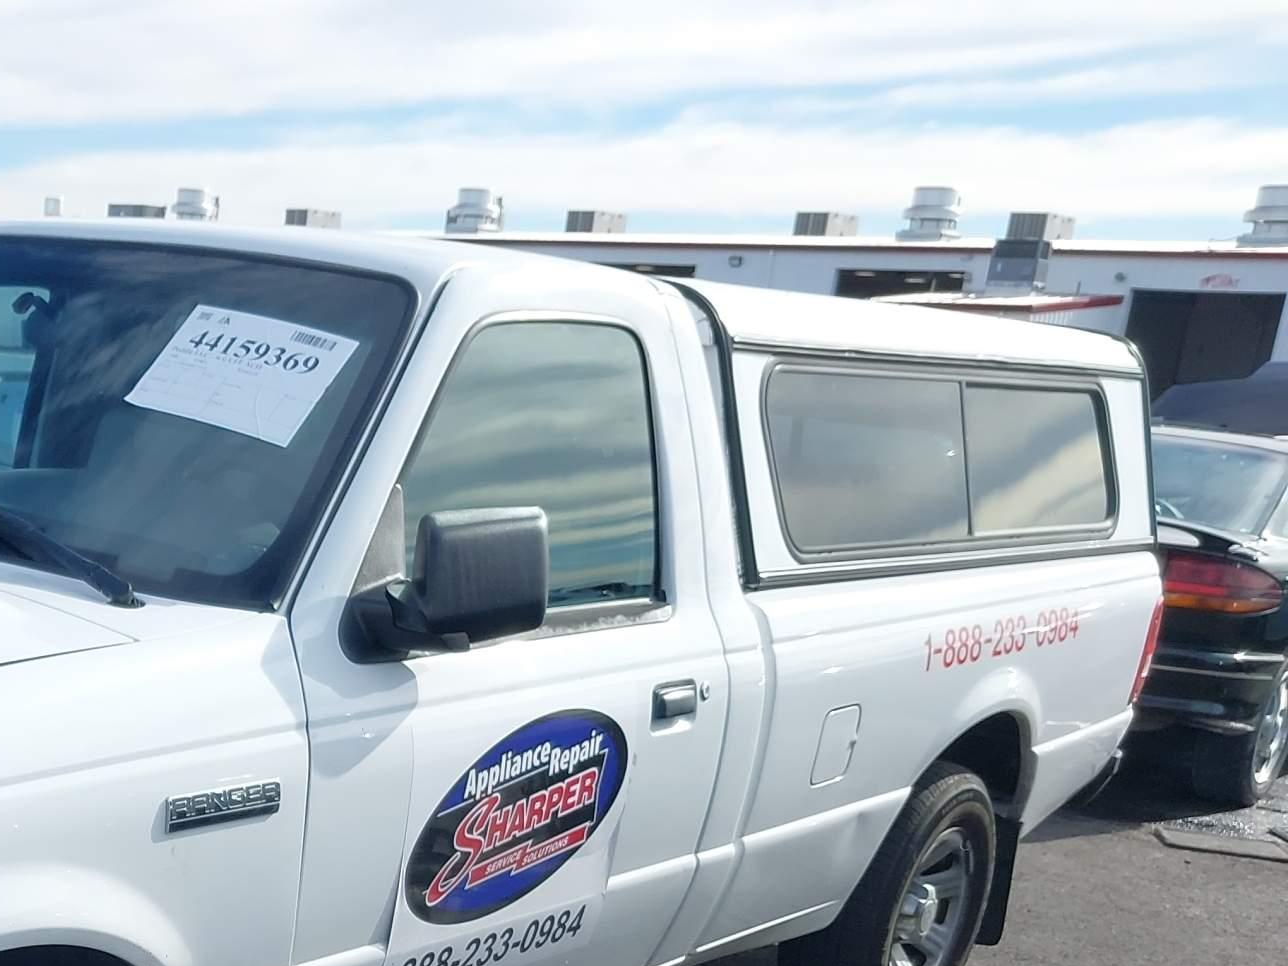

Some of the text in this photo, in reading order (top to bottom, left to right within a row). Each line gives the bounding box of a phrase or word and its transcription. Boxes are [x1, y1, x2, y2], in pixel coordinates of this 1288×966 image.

[189, 328, 320, 376] 44159369
[924, 607, 1079, 672] 1-888-233-0984
[464, 730, 603, 801] Appliance Repair
[169, 781, 281, 820] RANGER
[426, 766, 599, 907] SHARPER
[484, 836, 569, 876] SERVICE SOLUTIONS
